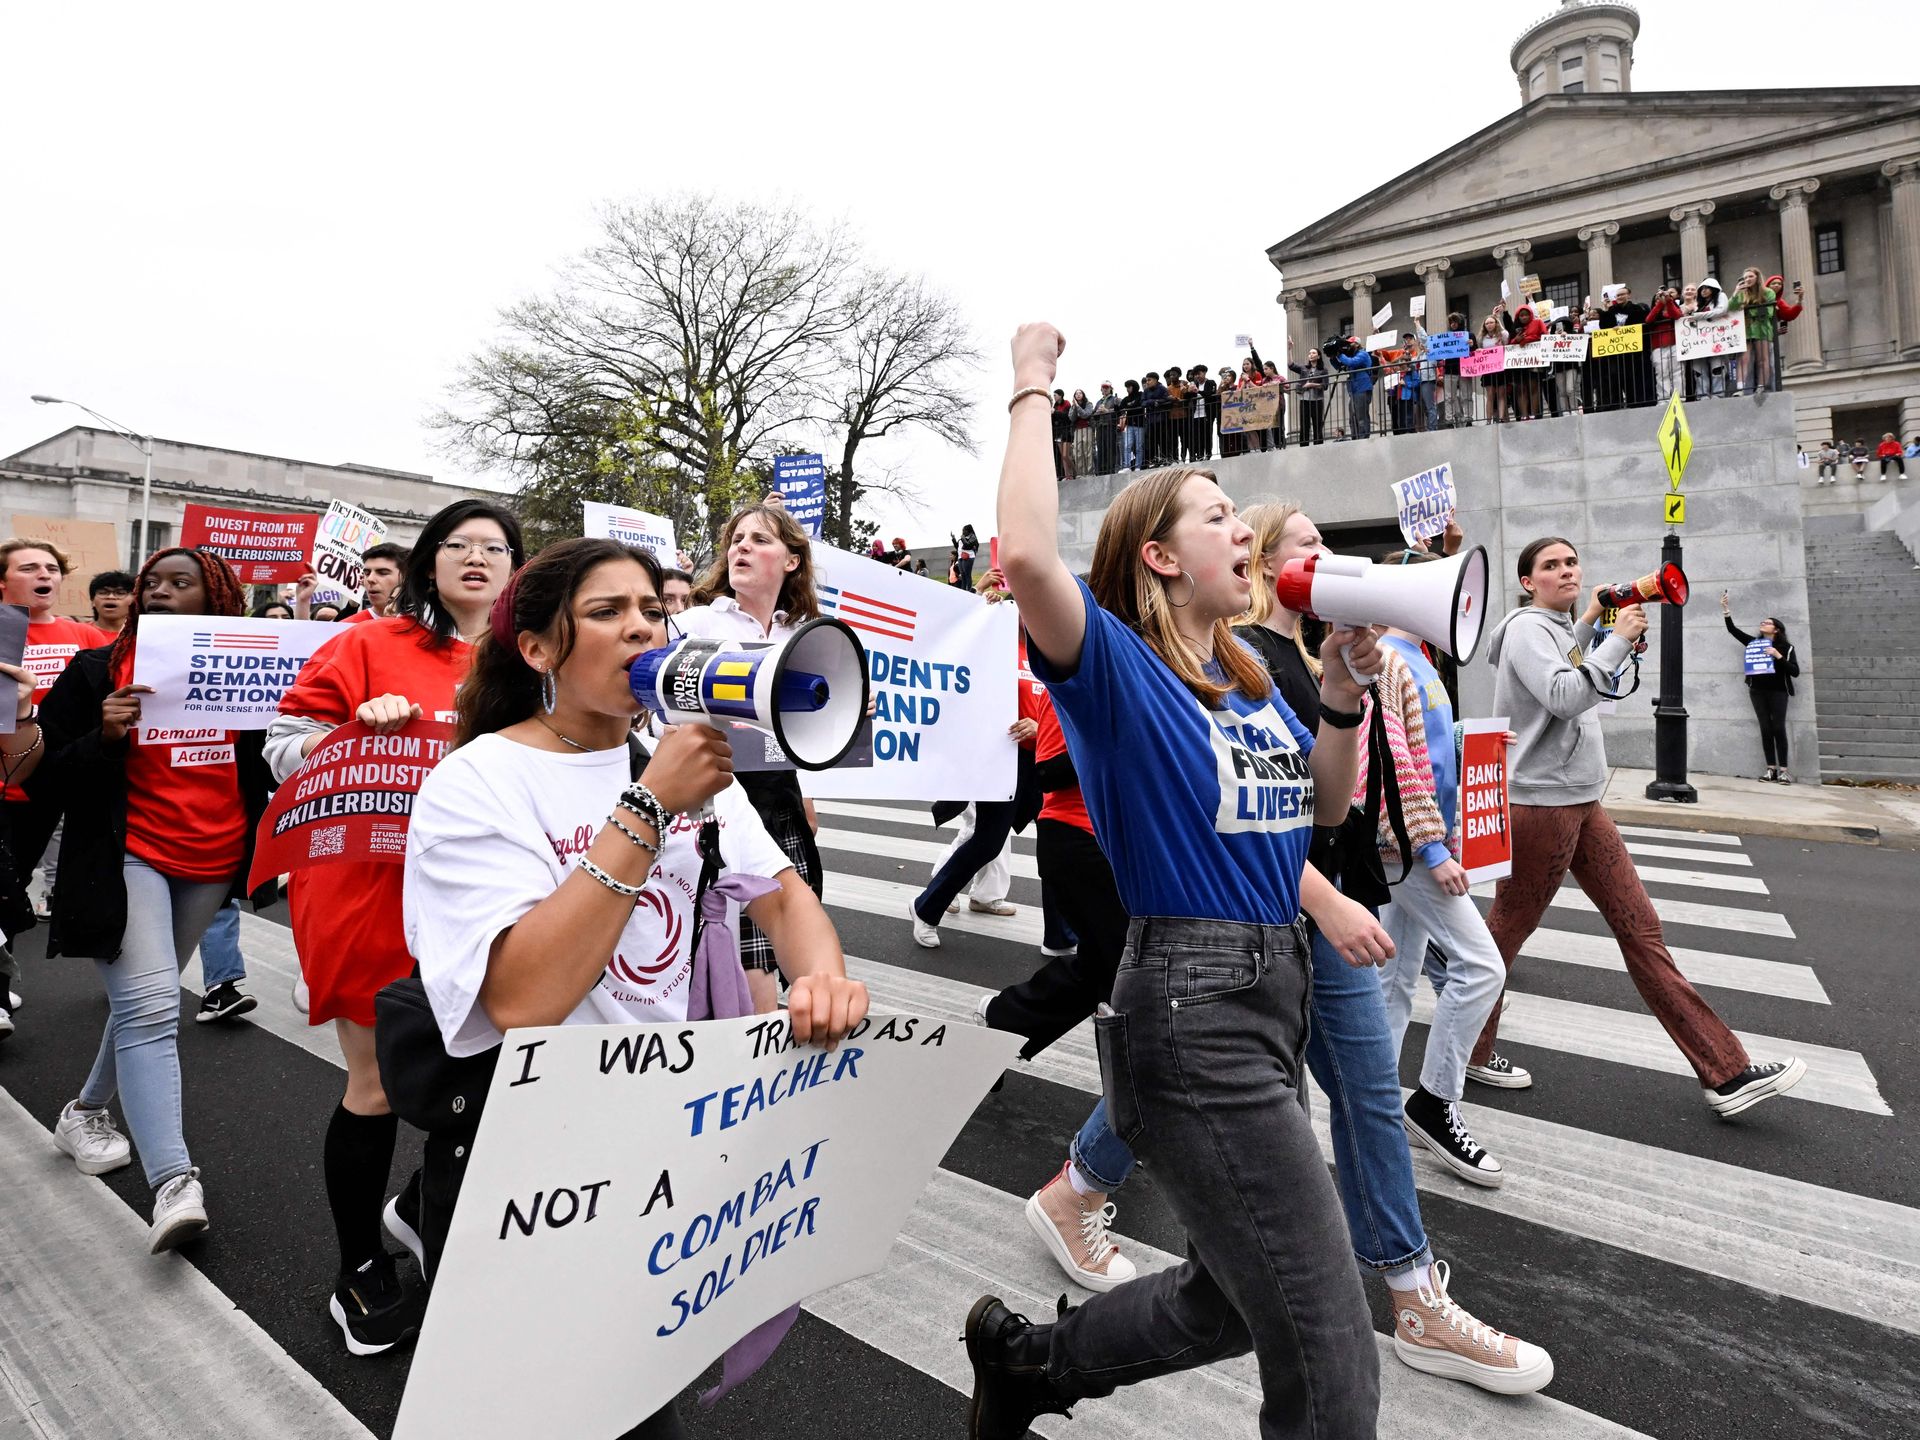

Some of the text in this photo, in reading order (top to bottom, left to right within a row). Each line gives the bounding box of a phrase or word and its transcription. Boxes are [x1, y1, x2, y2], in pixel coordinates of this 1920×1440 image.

[1594, 326, 1636, 339] BAN GUNS
[1597, 342, 1639, 355] BOOKS
[780, 467, 822, 478] STAND
[780, 481, 809, 493] UP
[784, 496, 823, 507] FIGHT
[1400, 490, 1451, 531] HEALTH
[205, 516, 305, 534] DIVEST FROM THE
[352, 510, 372, 525] miss
[209, 532, 297, 548] GUN INDUSTRY.
[330, 538, 348, 551] more
[608, 529, 667, 546] STUDENTS
[336, 549, 353, 563] miss
[23, 661, 60, 671] mand
[190, 654, 310, 671] STUDENT
[864, 648, 971, 694] DENTS
[188, 671, 297, 687] DEMAND
[673, 650, 702, 710] ENDLESS
[685, 667, 700, 710] WARS
[185, 688, 281, 703] ACTION
[184, 703, 202, 711] FOR
[205, 704, 223, 712] GUN
[225, 705, 253, 713] SENSE
[871, 690, 940, 726] AND
[177, 748, 231, 763] Action
[297, 735, 451, 779] DIVEST FROM TH
[1466, 762, 1503, 787] BANG
[294, 771, 334, 801] GUN
[1236, 786, 1302, 821] LIVES
[1466, 787, 1504, 813] BANG
[275, 792, 414, 835] #KILLERBUSI
[1467, 813, 1506, 839] BANG
[370, 837, 407, 845] DEMAND
[662, 955, 692, 998] STUDEN
[509, 1017, 946, 1087] I WAS TRAD AS A
[684, 1047, 865, 1137] TEACHER
[499, 1169, 675, 1240] NOT A
[646, 1138, 830, 1276] COMBAT
[655, 1197, 820, 1338] SOLDIER
